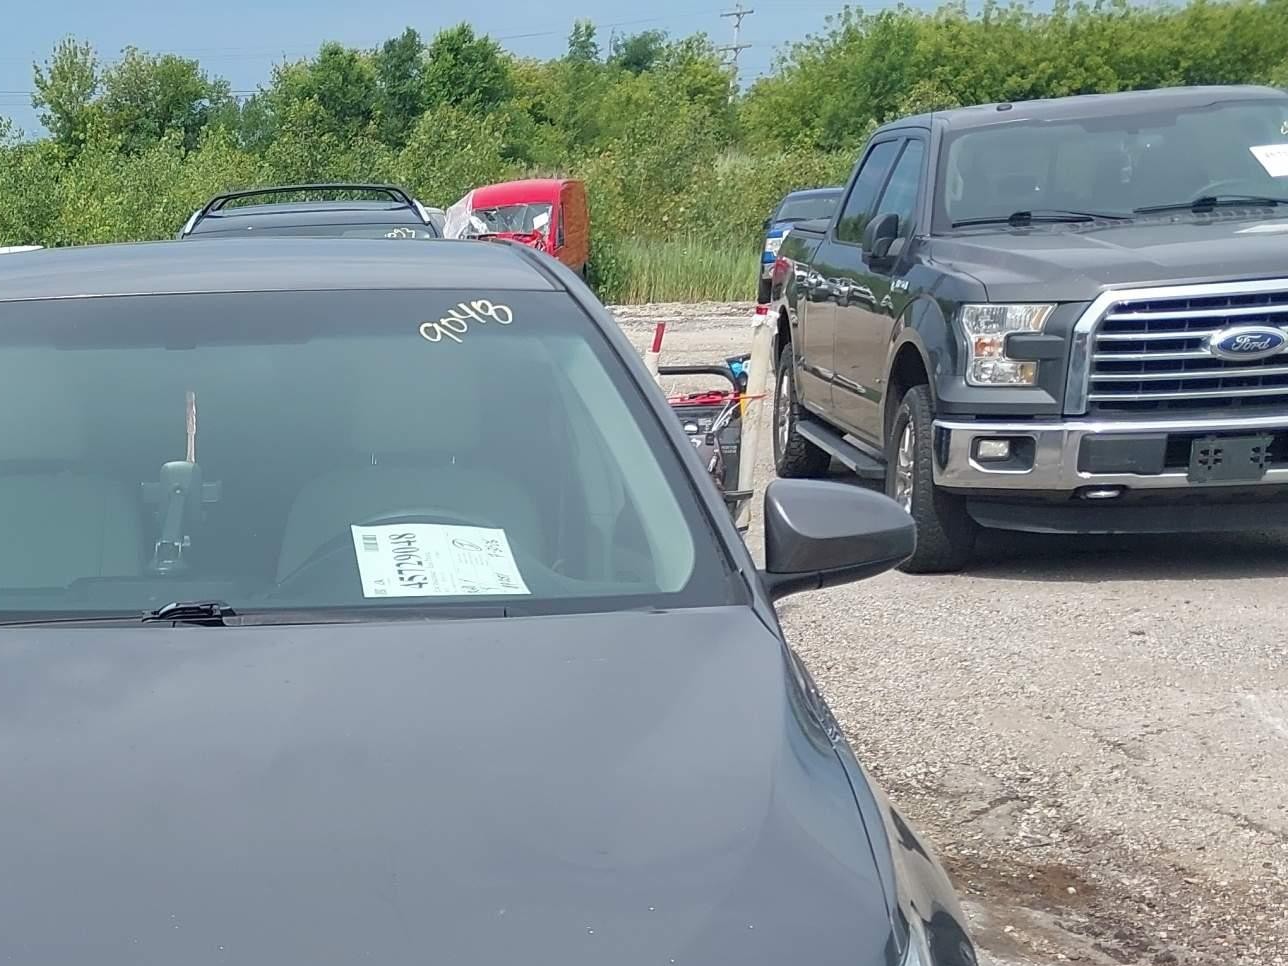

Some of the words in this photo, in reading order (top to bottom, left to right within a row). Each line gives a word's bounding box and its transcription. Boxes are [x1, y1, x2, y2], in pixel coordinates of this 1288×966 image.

[419, 299, 513, 343] 9048
[1232, 334, 1272, 352] Ford
[388, 532, 429, 589] 45729048
